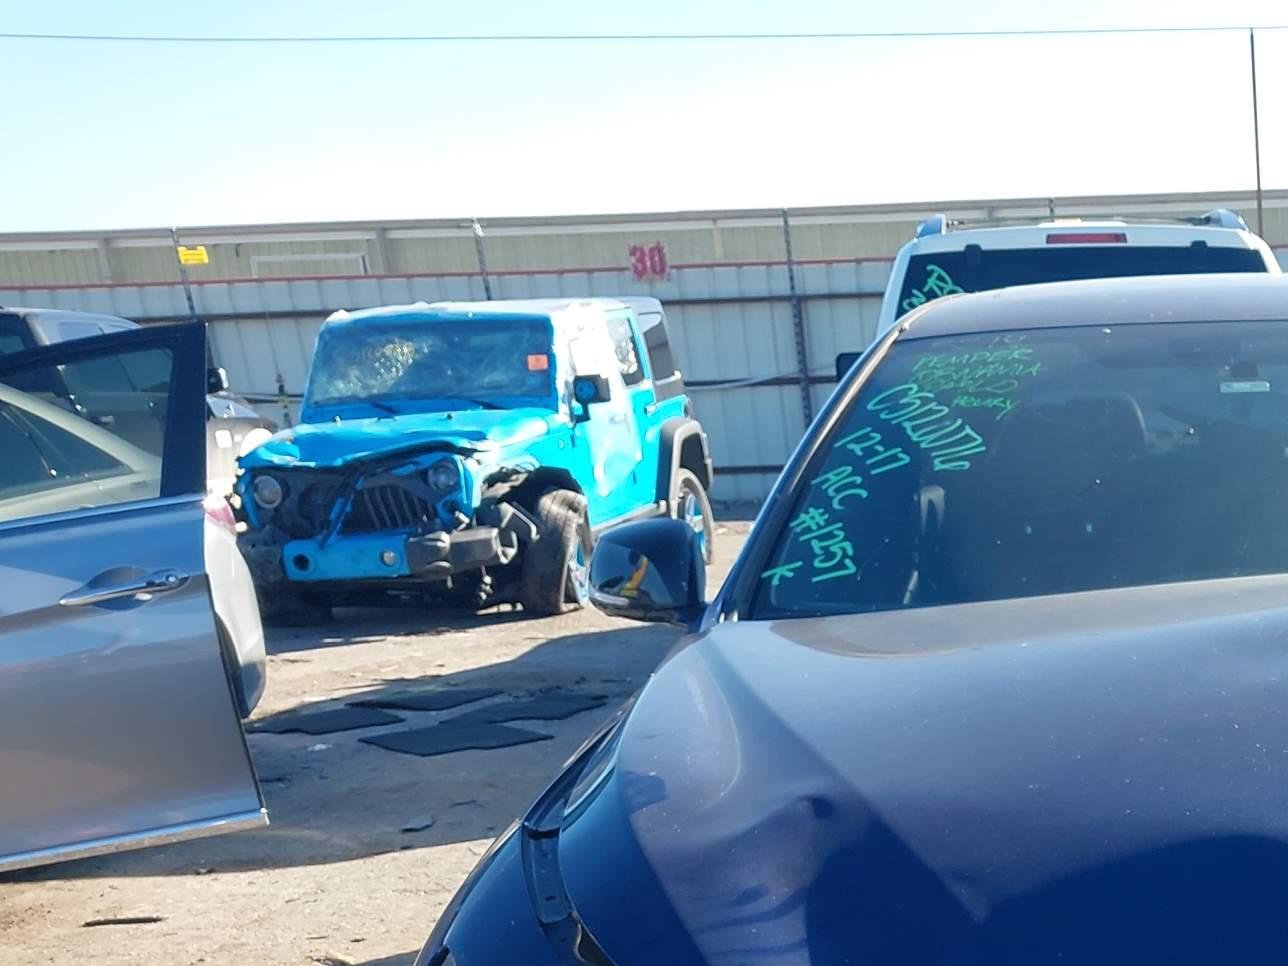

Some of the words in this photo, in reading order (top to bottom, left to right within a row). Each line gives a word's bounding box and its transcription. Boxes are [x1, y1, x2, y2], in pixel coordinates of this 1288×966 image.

[629, 243, 667, 279] 30
[834, 427, 911, 475] 12-17
[811, 465, 868, 510] ACC
[789, 507, 857, 582] #1257
